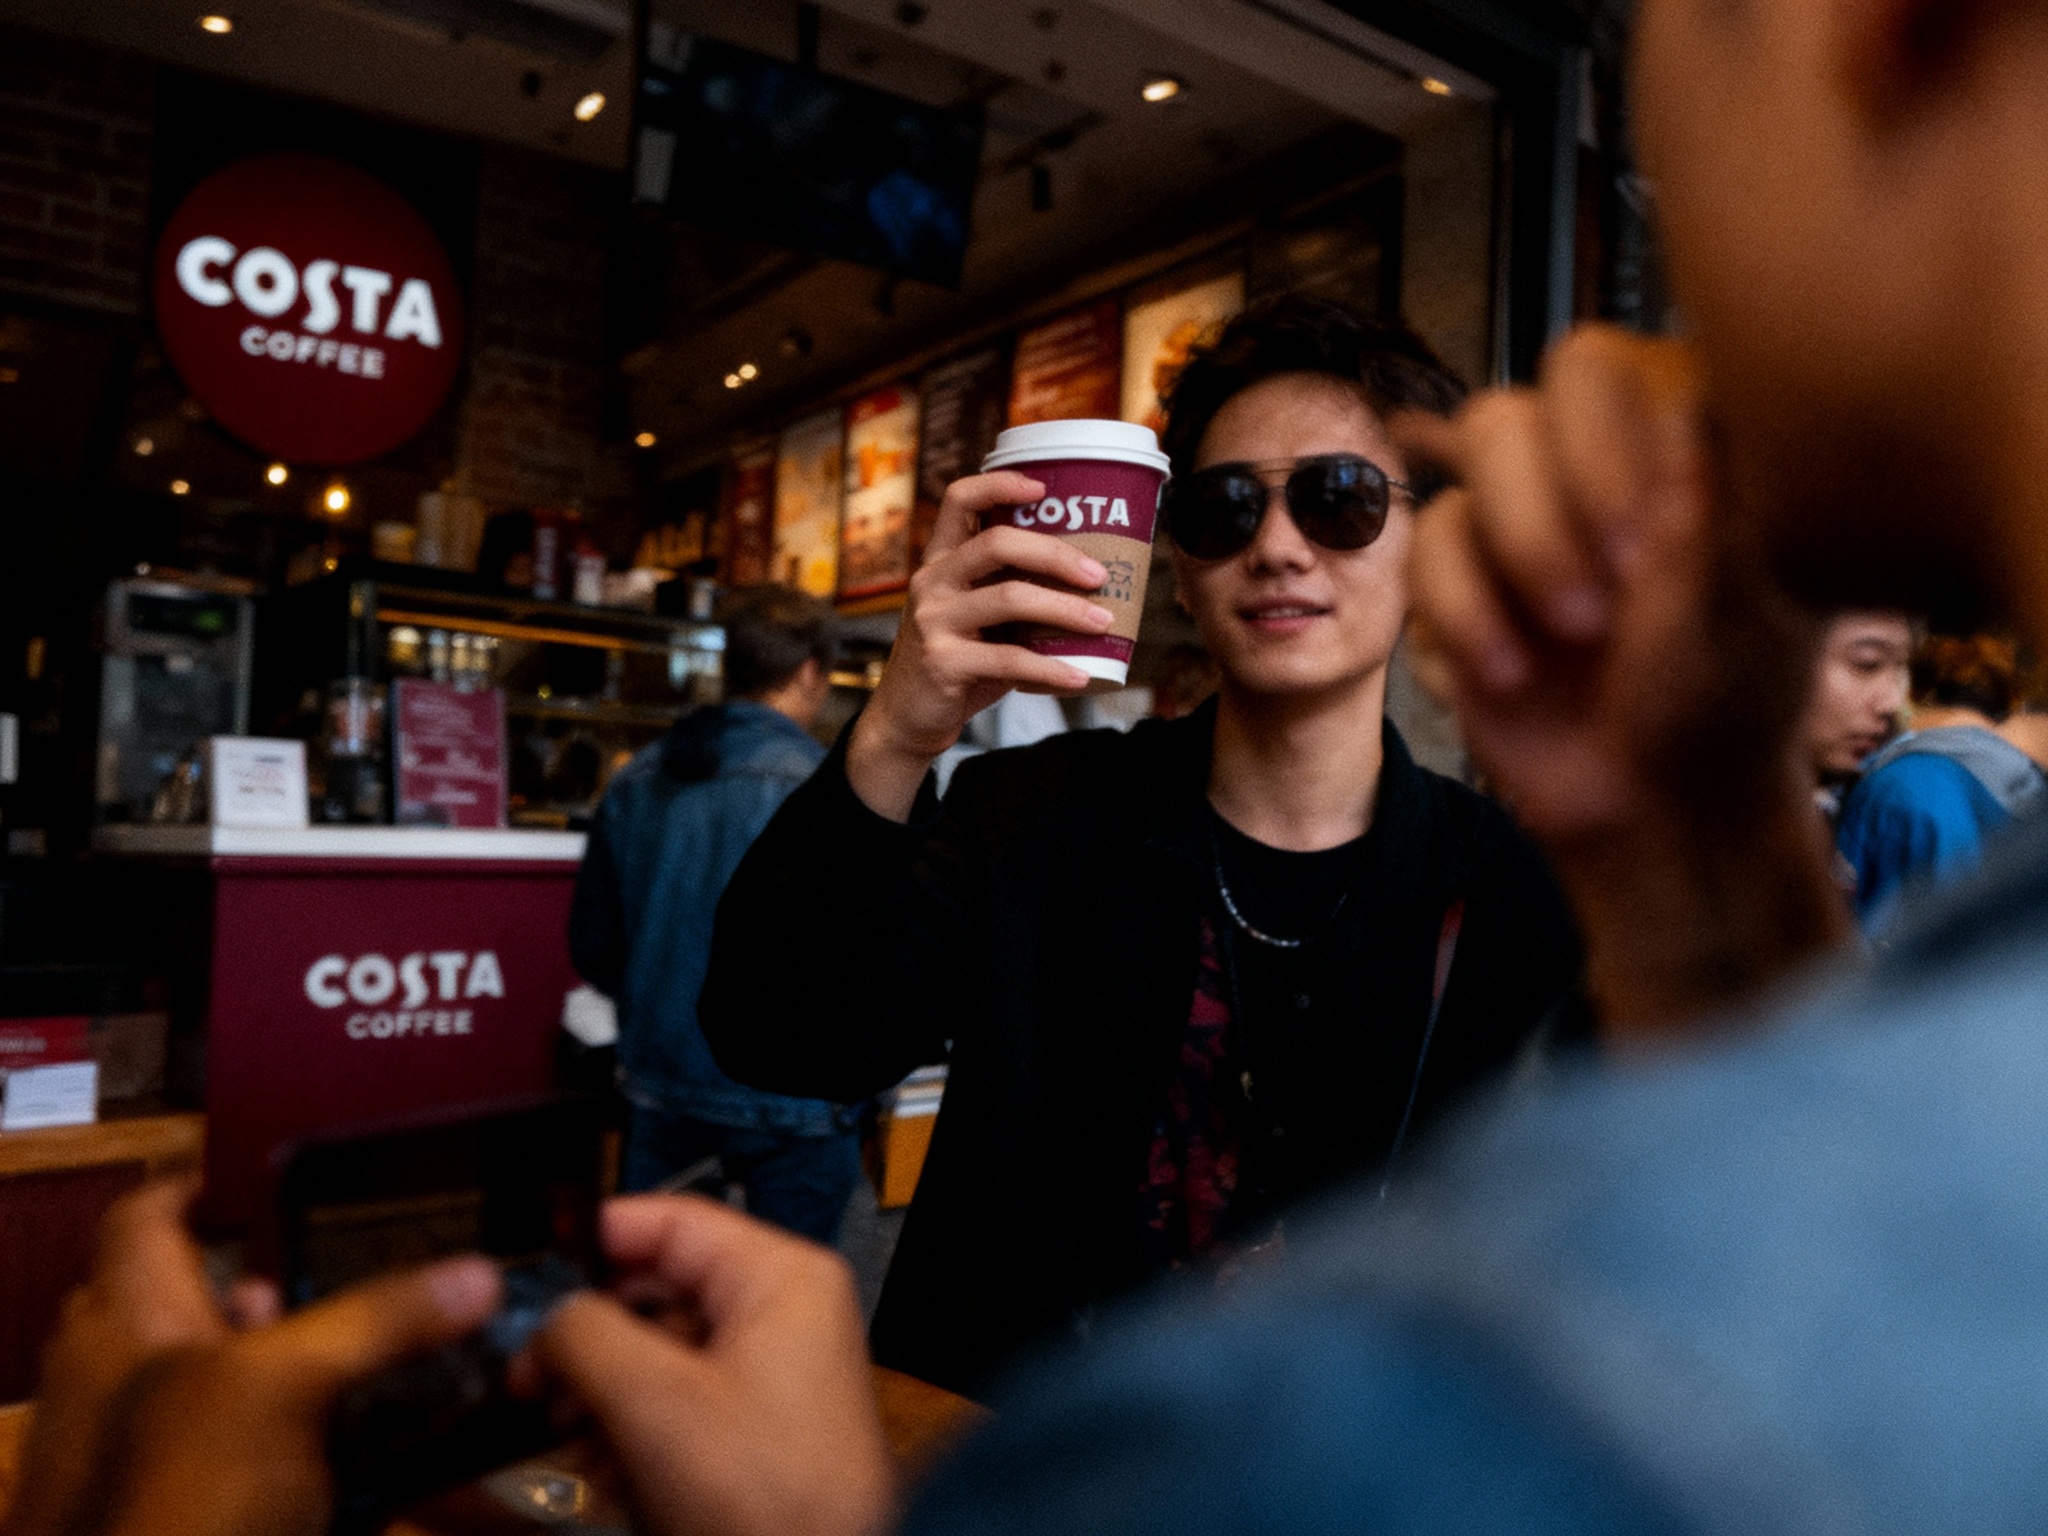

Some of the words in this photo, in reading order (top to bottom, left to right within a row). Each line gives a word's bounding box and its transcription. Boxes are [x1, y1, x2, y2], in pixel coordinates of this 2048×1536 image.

[175, 235, 443, 349] COSTA
[240, 325, 385, 380] COFFEE
[1014, 496, 1130, 530] COSTA
[305, 952, 504, 1009] COSTA
[346, 1009, 473, 1040] COFFEE
